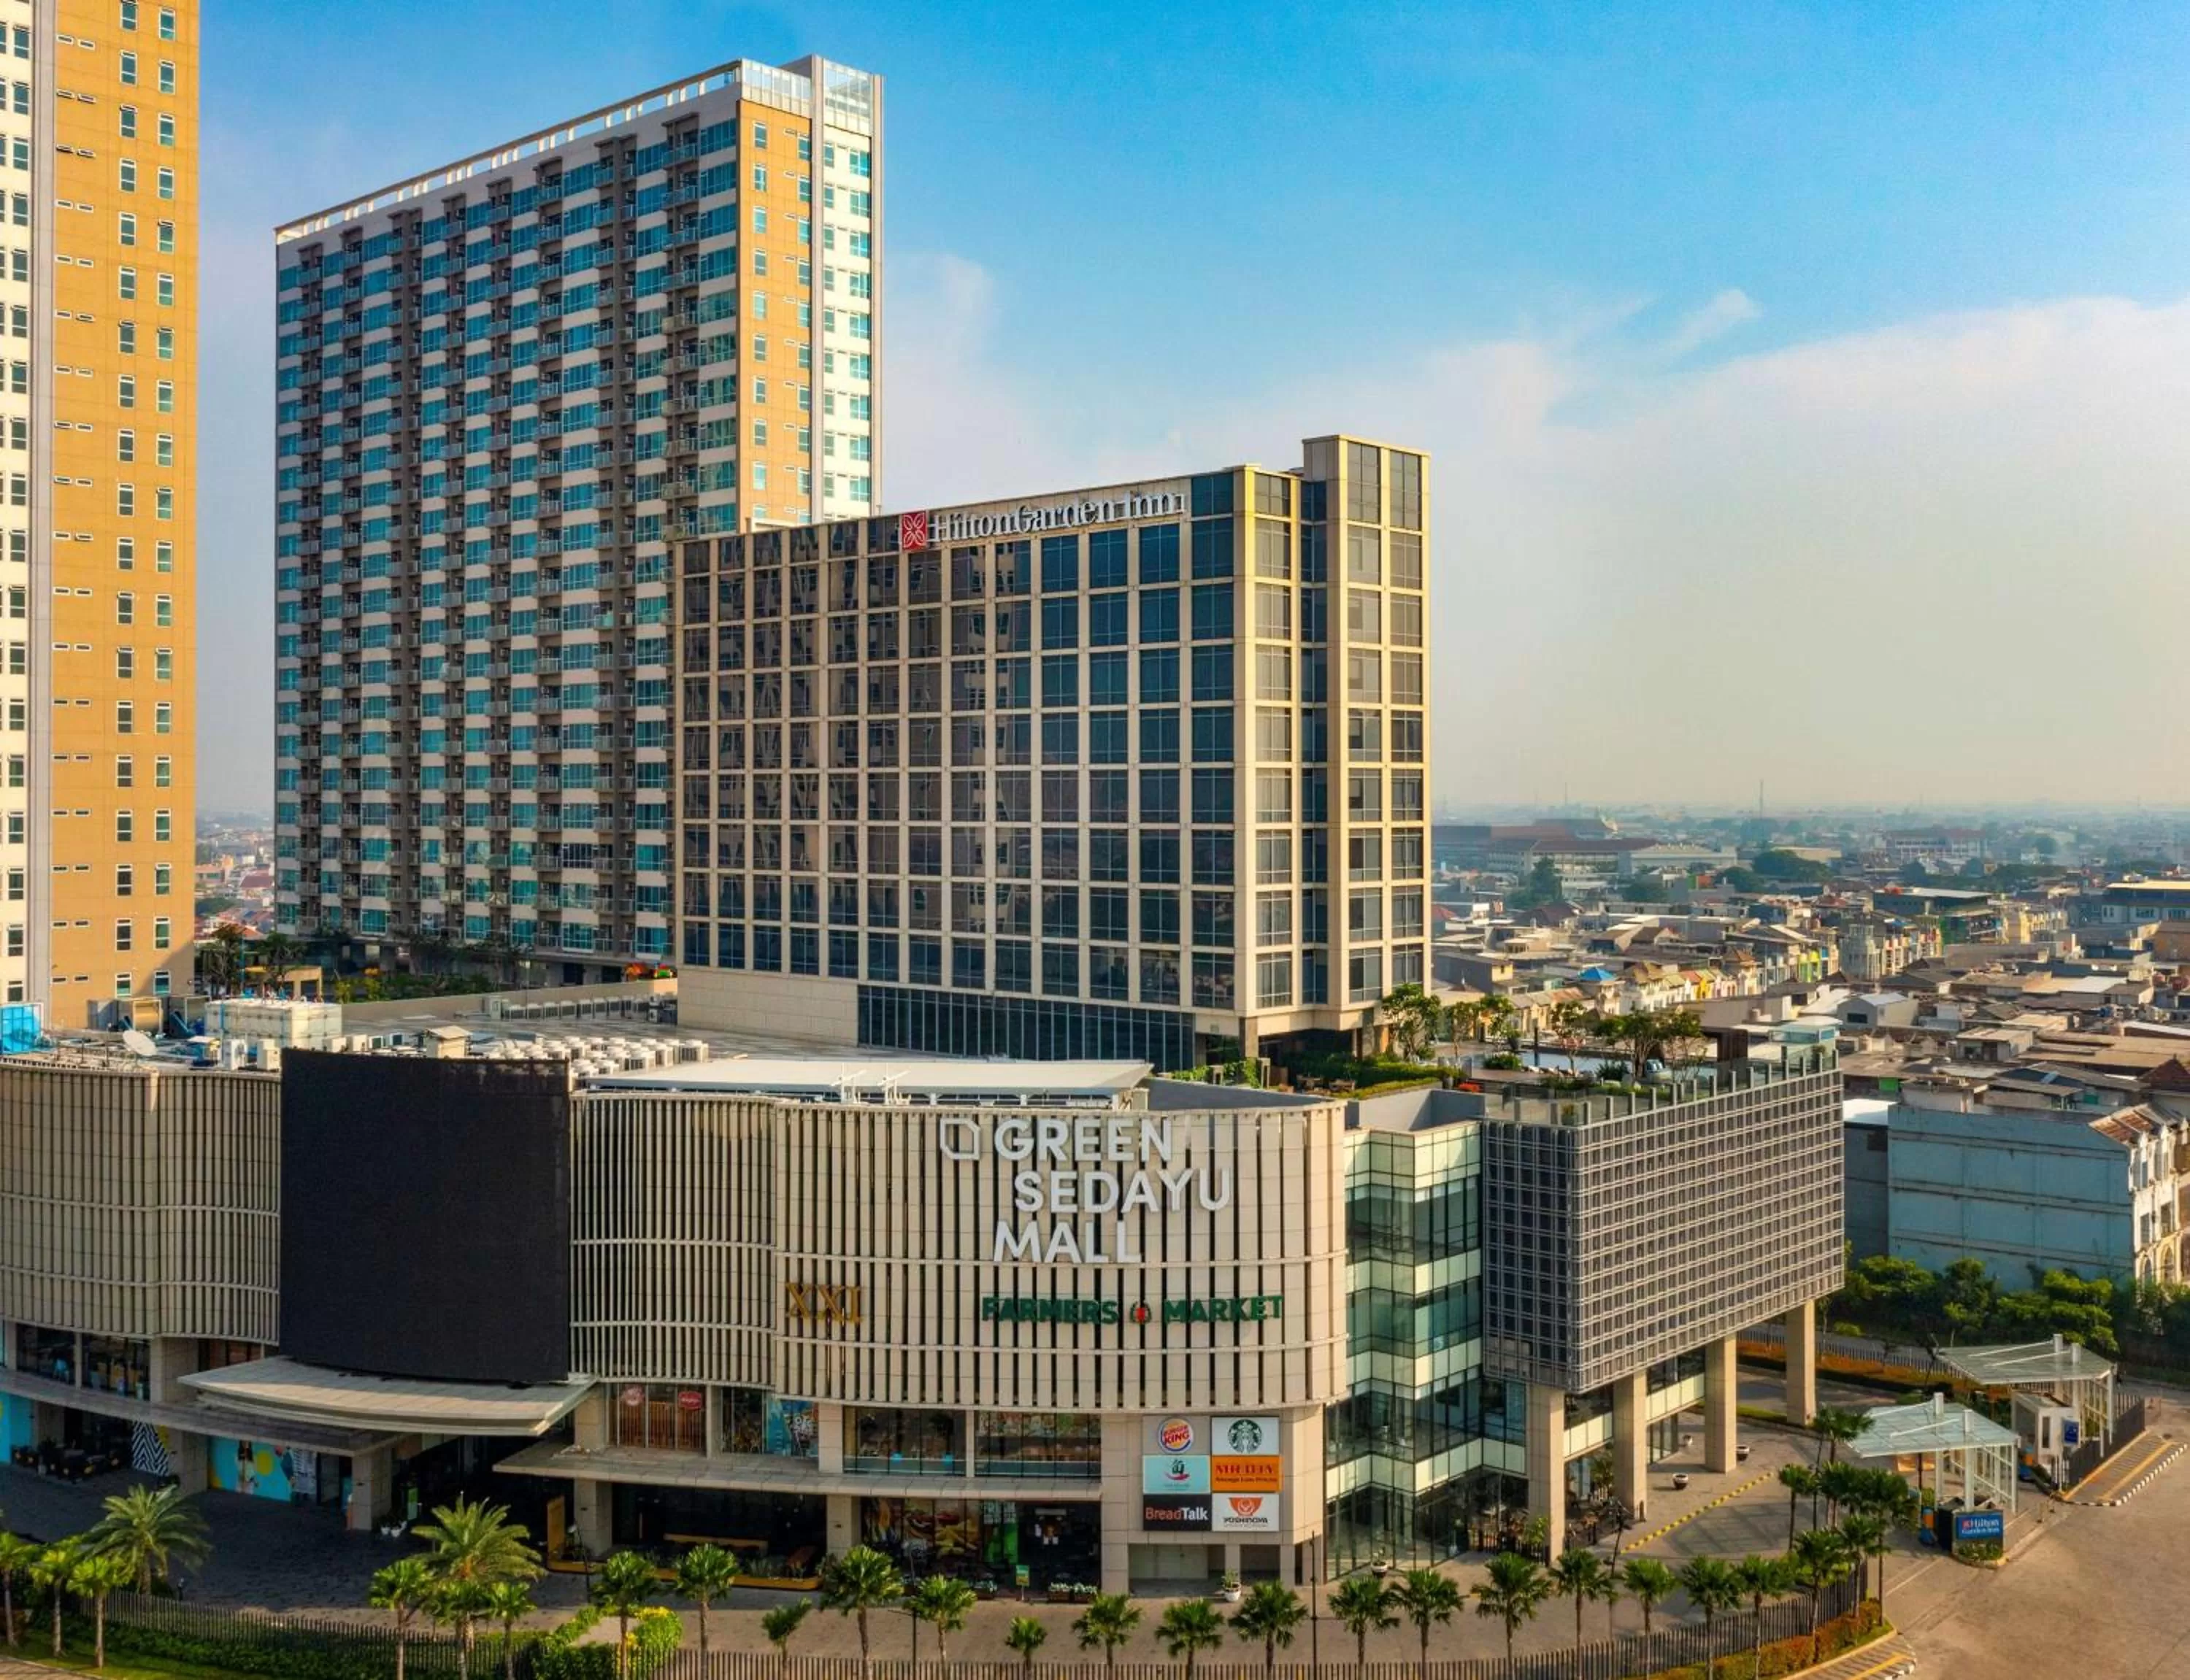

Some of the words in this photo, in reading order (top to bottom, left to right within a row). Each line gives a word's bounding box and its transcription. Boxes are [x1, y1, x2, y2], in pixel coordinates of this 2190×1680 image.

[927, 512, 1017, 542] Hilton
[1015, 493, 1117, 533] Garden
[994, 1119, 1172, 1162] GREEN
[1014, 1169, 1231, 1213] SEDAYU
[994, 1220, 1142, 1263] MALL
[785, 1283, 862, 1323] XXI
[982, 1297, 1119, 1324] FARMERS
[1163, 1295, 1284, 1323] MARKET
[1164, 1430, 1190, 1445] KING
[1145, 1507, 1209, 1520] BreadTalk
